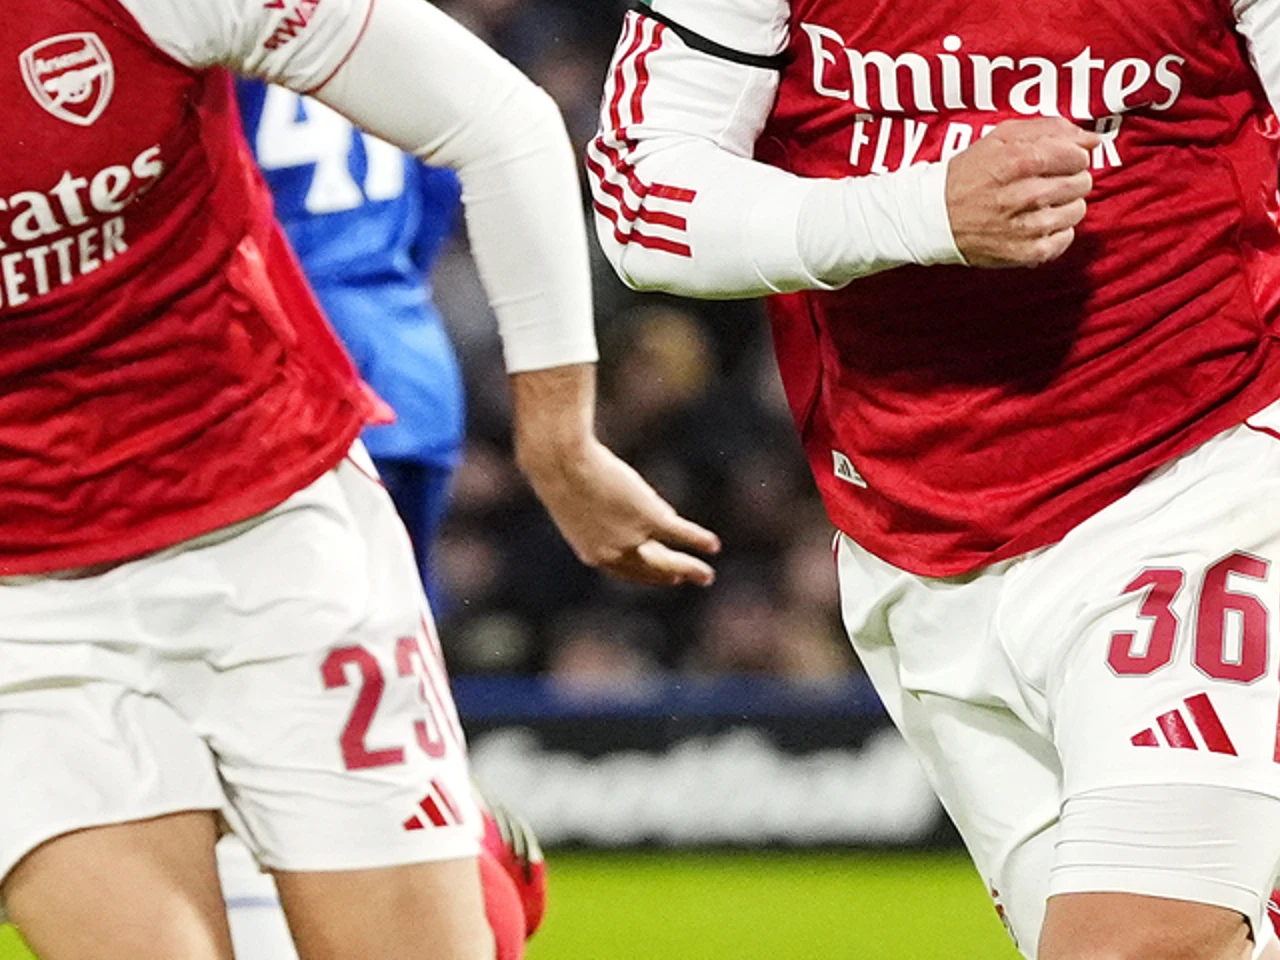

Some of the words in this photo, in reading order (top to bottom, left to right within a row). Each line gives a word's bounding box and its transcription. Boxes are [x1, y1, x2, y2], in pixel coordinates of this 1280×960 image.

[800, 21, 1186, 121] Emirates
[849, 113, 928, 176] FLY
[1106, 549, 1272, 685] 36
[320, 635, 447, 773] 23
